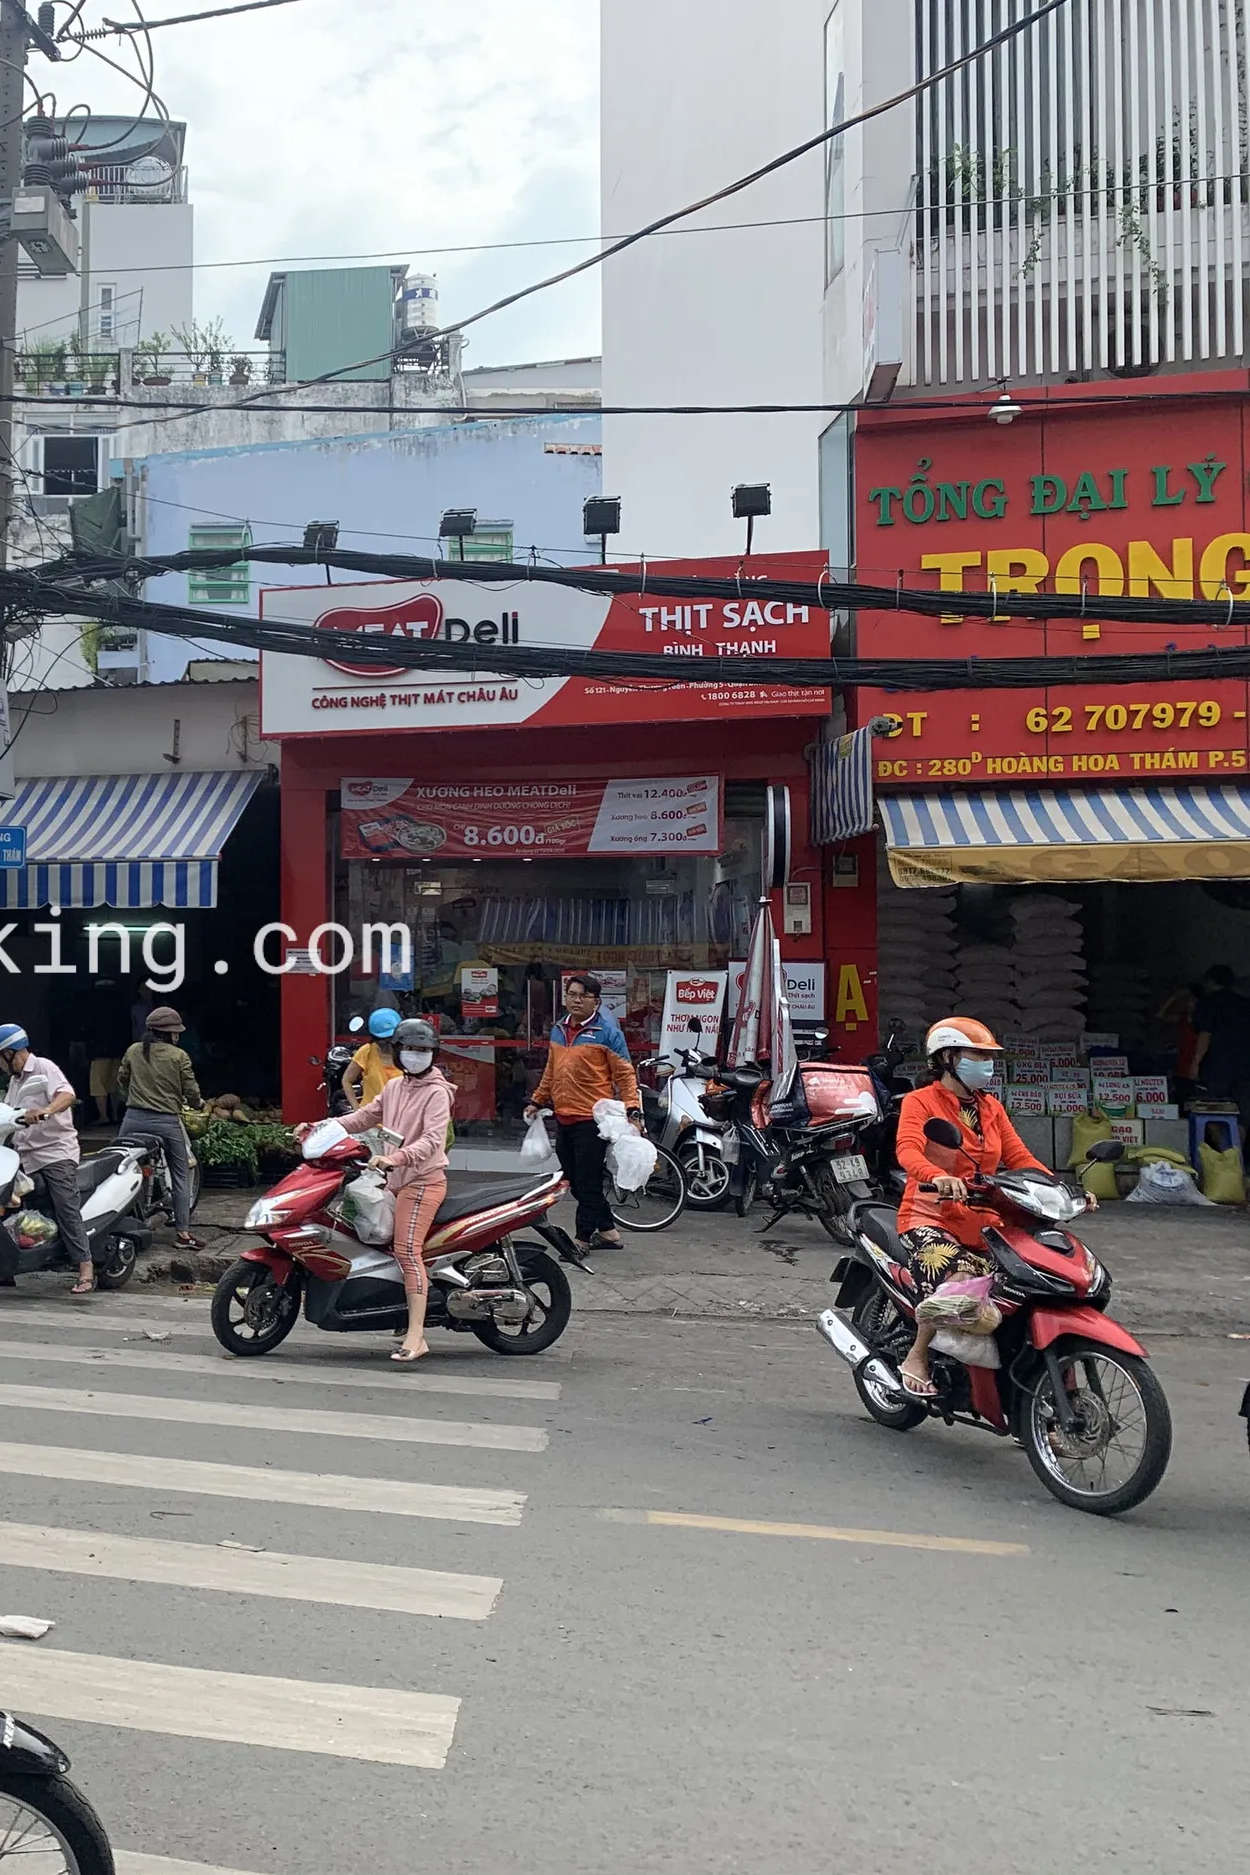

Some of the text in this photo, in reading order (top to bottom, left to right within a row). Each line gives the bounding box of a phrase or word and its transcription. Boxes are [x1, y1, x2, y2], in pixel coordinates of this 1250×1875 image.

[868, 453, 1227, 526] TỔNG ĐẠI LÝ
[639, 601, 809, 636] THỊT SẠCH
[445, 611, 519, 644] Deli
[663, 640, 776, 658] BÌNH THẠNH
[312, 686, 519, 709] CÔNG NGHỆ THỊT MÁT CHÂU ÂU
[708, 690, 756, 701] 1800 6828
[1026, 706, 1073, 733] 62
[1084, 700, 1222, 732] 707979
[877, 760, 909, 778] ĐC
[986, 752, 1064, 774] HOÀNG
[1072, 754, 1120, 772] HOA
[1130, 747, 1199, 770] THÁM
[1208, 750, 1247, 769] P.5
[417, 786, 470, 798] XƯƠNG
[473, 786, 504, 797] HEO
[787, 978, 815, 991] Deli
[678, 987, 716, 1003] Bếp Việt
[1016, 1073, 1048, 1084] 25.000
[1010, 1101, 1042, 1111] 12.500
[1098, 1093, 1130, 1102] 12.500
